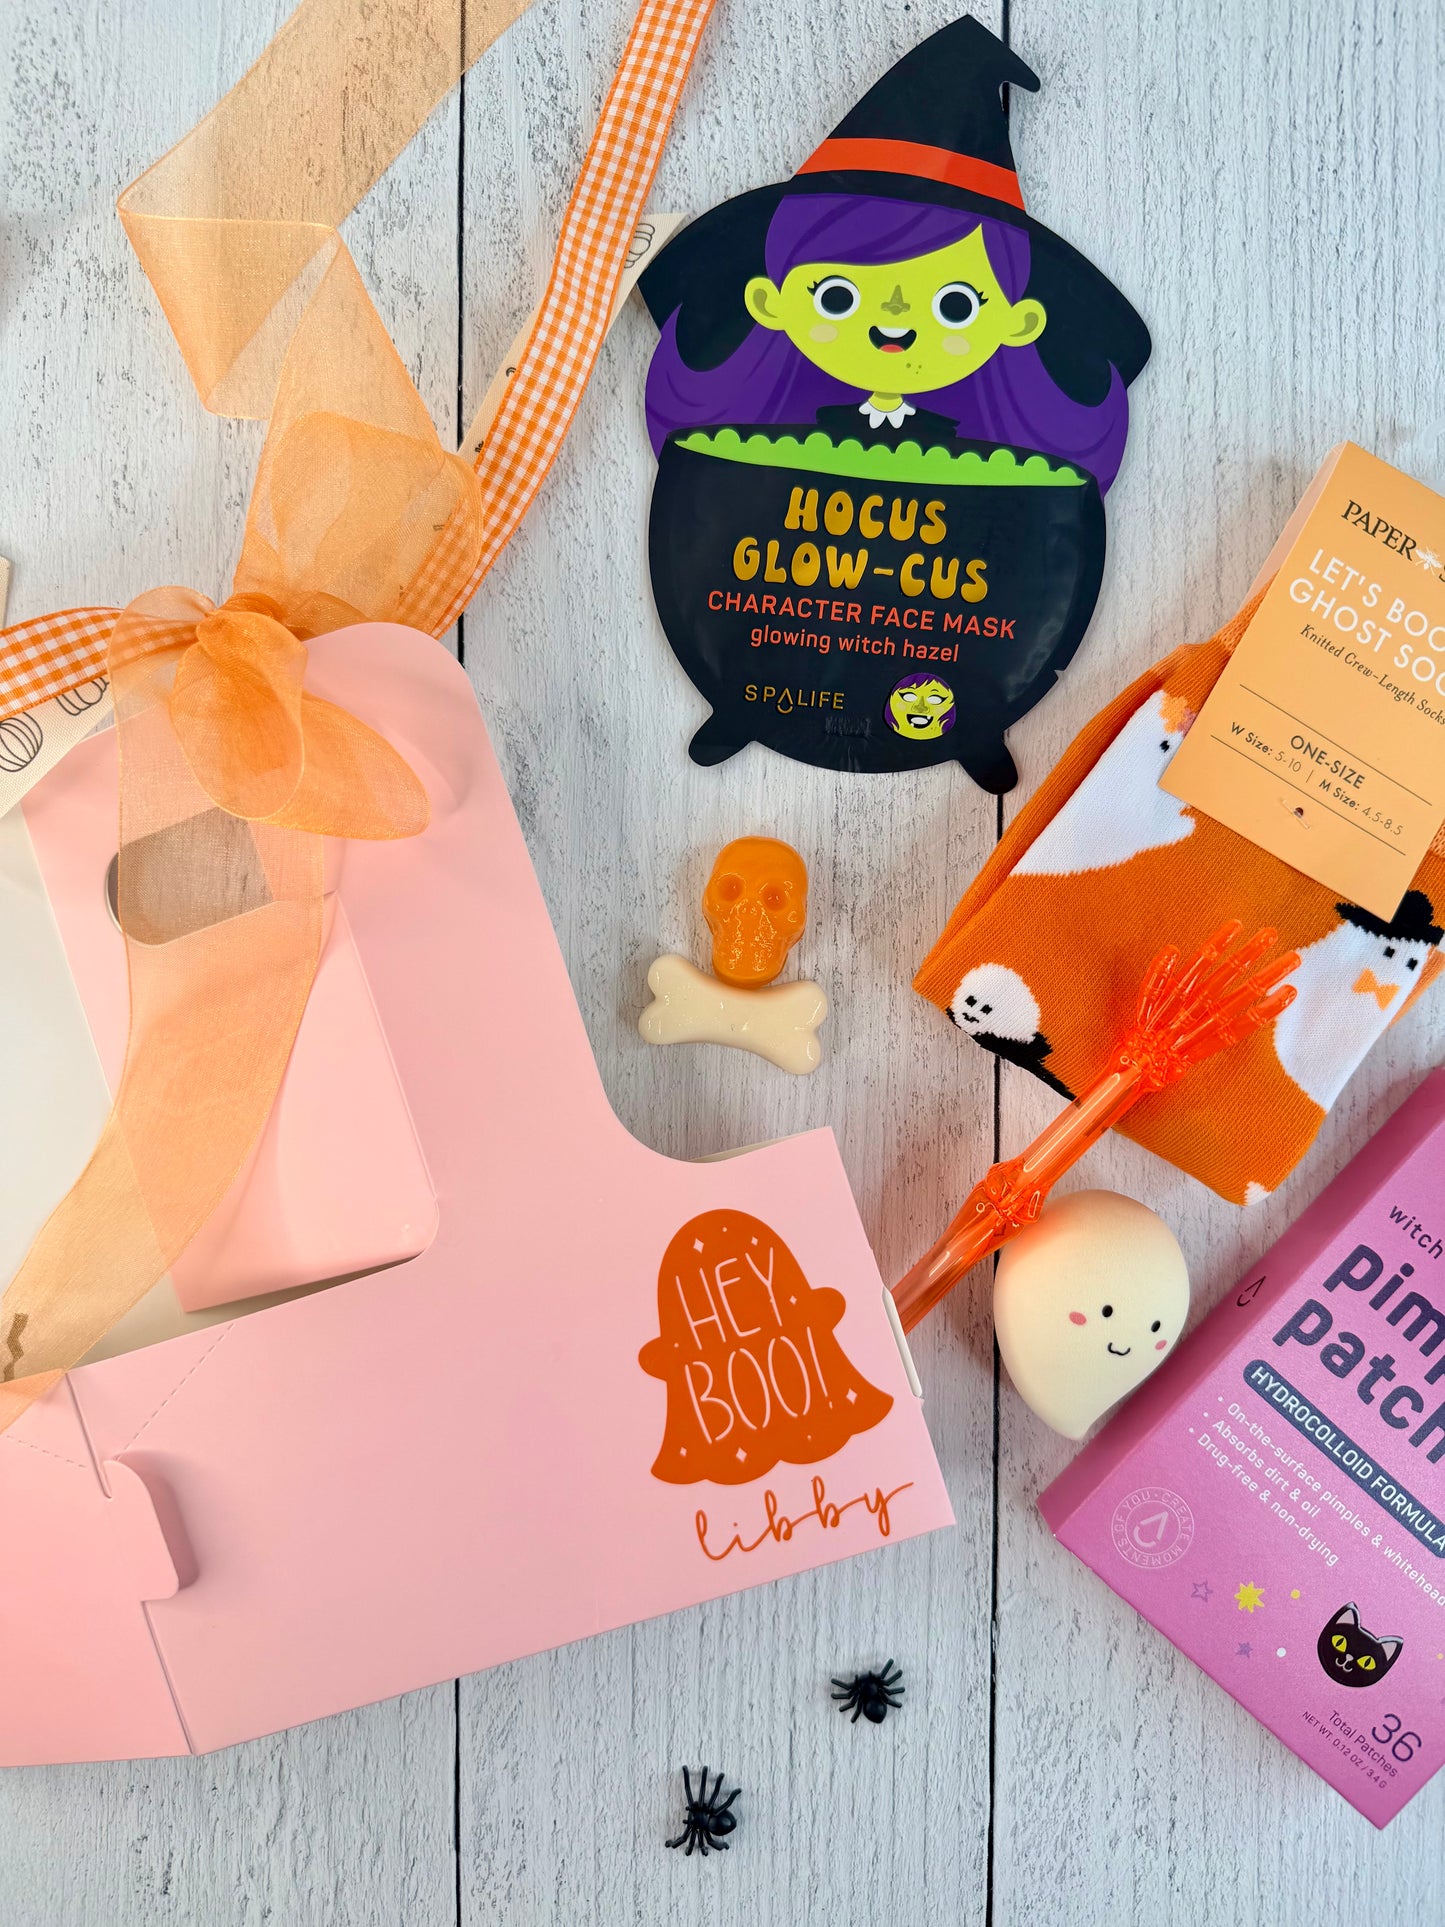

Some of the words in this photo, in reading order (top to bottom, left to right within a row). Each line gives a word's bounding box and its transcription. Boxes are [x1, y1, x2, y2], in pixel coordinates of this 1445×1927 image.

[783, 486, 947, 545] HOCUS
[1341, 499, 1417, 561] PAPER
[732, 536, 989, 603] GLOW-CUS
[1309, 548, 1382, 608] LET'S
[707, 590, 862, 624] CHARACTER
[870, 605, 934, 631] FACE
[943, 613, 1017, 640] MASK
[750, 625, 831, 654] glowing
[838, 633, 896, 657] witch
[903, 639, 959, 662] hazel
[1288, 577, 1392, 653] GHOST
[1300, 624, 1344, 658] Knitted
[1344, 652, 1415, 705] Crew-Length
[1231, 721, 1246, 736] W
[1245, 732, 1273, 756] Size:
[1274, 751, 1302, 773] 5-10
[1318, 779, 1332, 793] M
[1332, 787, 1360, 811] Size:
[1361, 807, 1403, 836] 4.5-8.5
[1290, 735, 1366, 789] ONE-SIZE
[1389, 1205, 1443, 1260] witch
[675, 1247, 783, 1350] HEY
[684, 1326, 833, 1445] BOO!
[1212, 1420, 1264, 1469] Absorbs
[1264, 1467, 1290, 1492] dirt
[1289, 1488, 1301, 1503] &
[1301, 1499, 1321, 1519] oil
[1227, 1402, 1322, 1492] On-the-surface
[1319, 1490, 1371, 1538] pimples
[1371, 1535, 1384, 1549] &
[1250, 1366, 1374, 1480] HYDROCOLLOID
[1370, 1475, 1445, 1551] FORMULA
[695, 1475, 914, 1561] libby
[1197, 1433, 1259, 1492] Drug-free
[1259, 1489, 1271, 1504] &
[1270, 1500, 1339, 1567] non-drying
[1302, 1711, 1321, 1728] NET
[1332, 1738, 1351, 1757] 0.12
[1329, 1710, 1357, 1739] Total
[1353, 1734, 1398, 1778] Patches
[1371, 1713, 1422, 1762] 36
